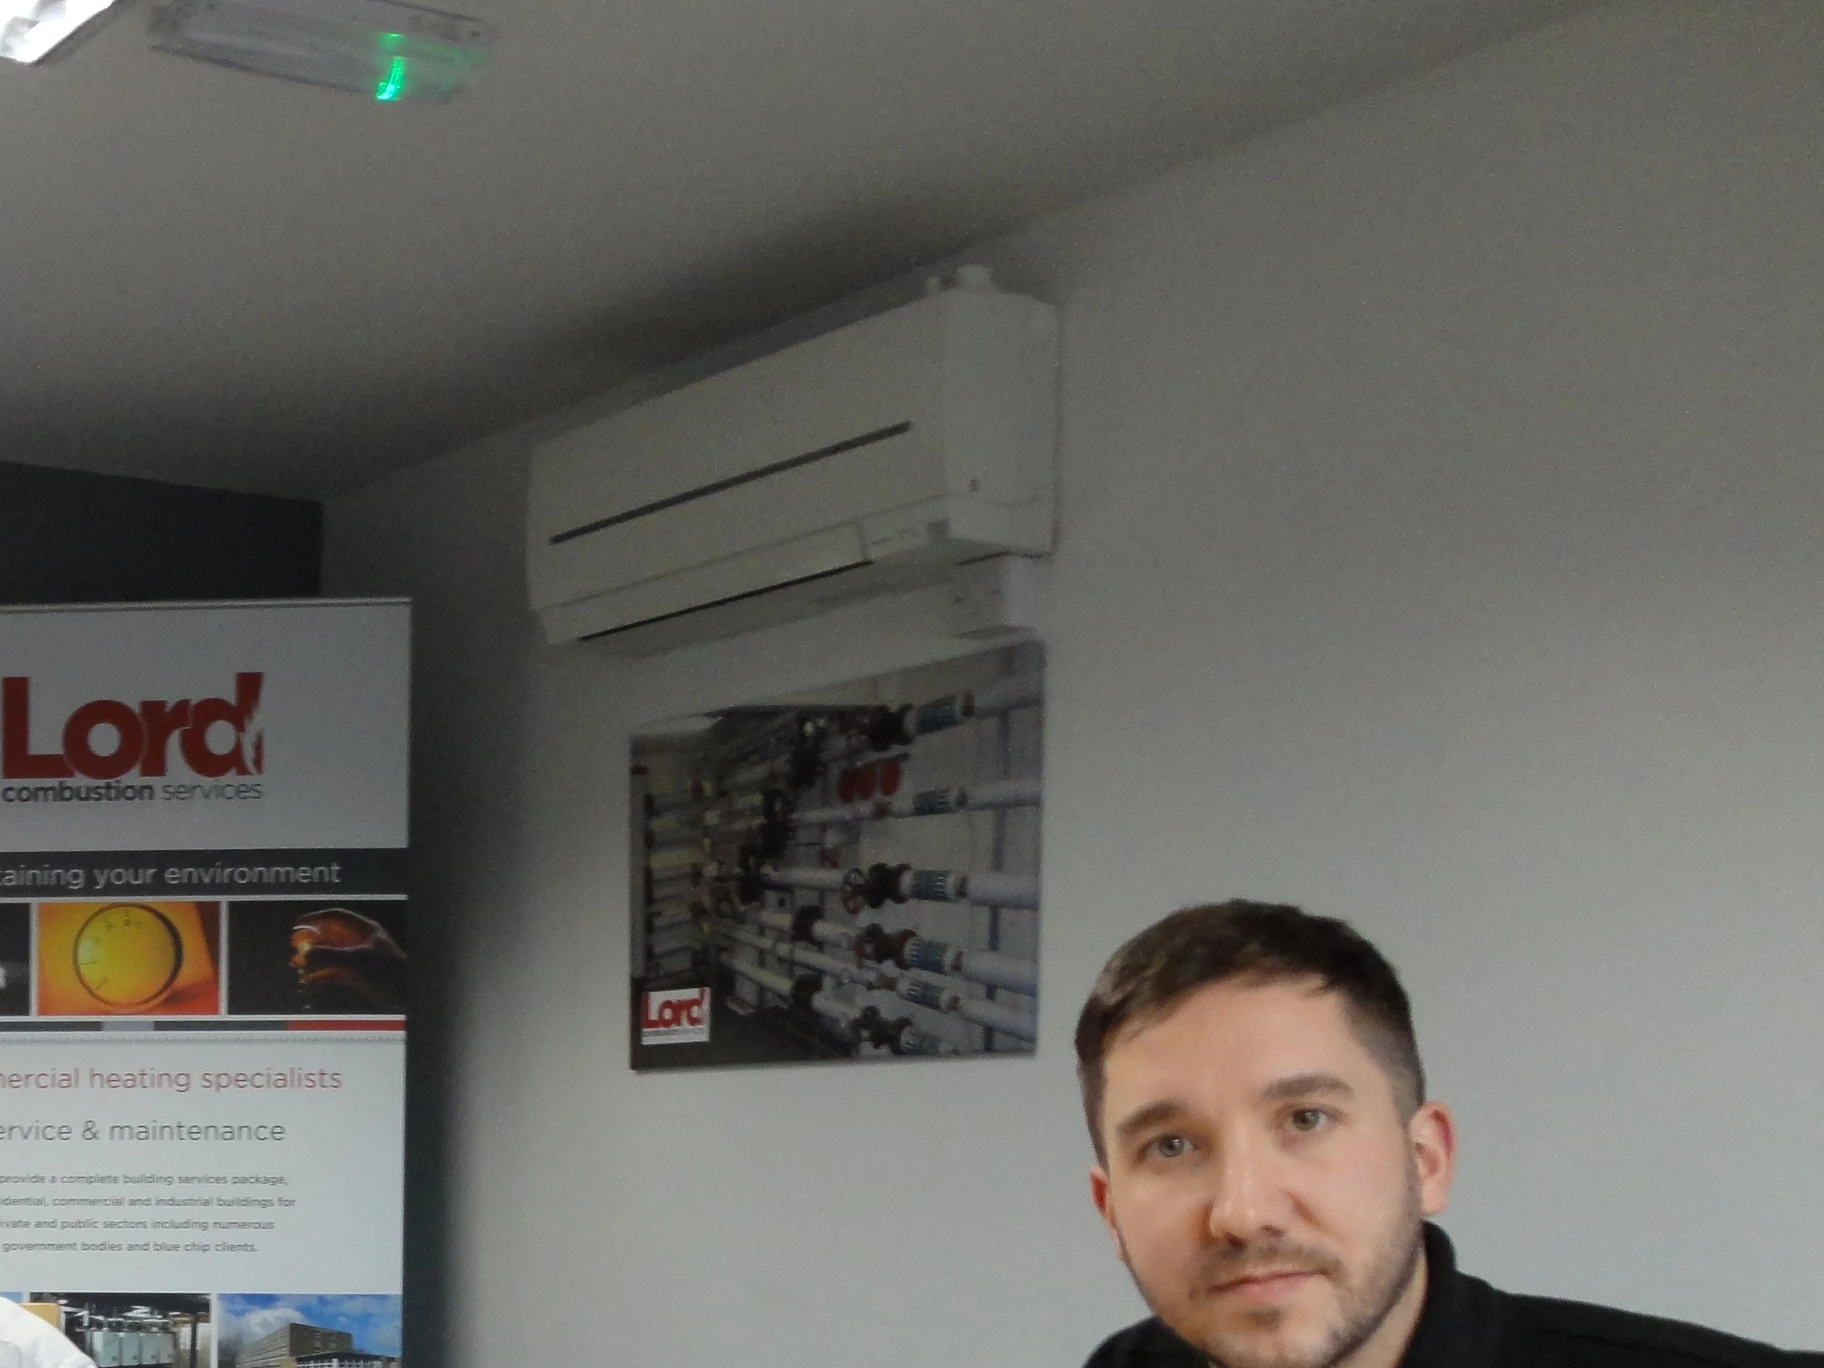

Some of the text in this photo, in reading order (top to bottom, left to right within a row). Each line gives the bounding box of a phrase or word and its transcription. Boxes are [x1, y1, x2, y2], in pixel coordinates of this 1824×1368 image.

[1, 672, 264, 779] Lord
[2, 779, 263, 803] combustion services
[94, 867, 155, 890] your
[164, 861, 341, 886] environment
[642, 986, 708, 1029] Lord
[90, 1068, 192, 1093] heating
[200, 1067, 343, 1093] specialists
[82, 1120, 100, 1142] &
[109, 1120, 286, 1142] maintenance
[49, 1176, 57, 1184] a
[60, 1174, 119, 1186] complete
[123, 1174, 174, 1186] building
[177, 1175, 228, 1185] services
[231, 1174, 289, 1186] package,
[52, 1196, 125, 1207] commercial
[129, 1197, 152, 1207] and
[155, 1196, 214, 1207] industrial
[217, 1196, 275, 1209] buildings
[277, 1197, 296, 1207] for
[34, 1219, 57, 1229] and
[60, 1219, 99, 1230] public
[103, 1219, 148, 1230] sectors
[152, 1219, 209, 1231] including
[212, 1220, 275, 1230] numerous
[1, 1241, 259, 1253] government bodies and blue chip clients.
